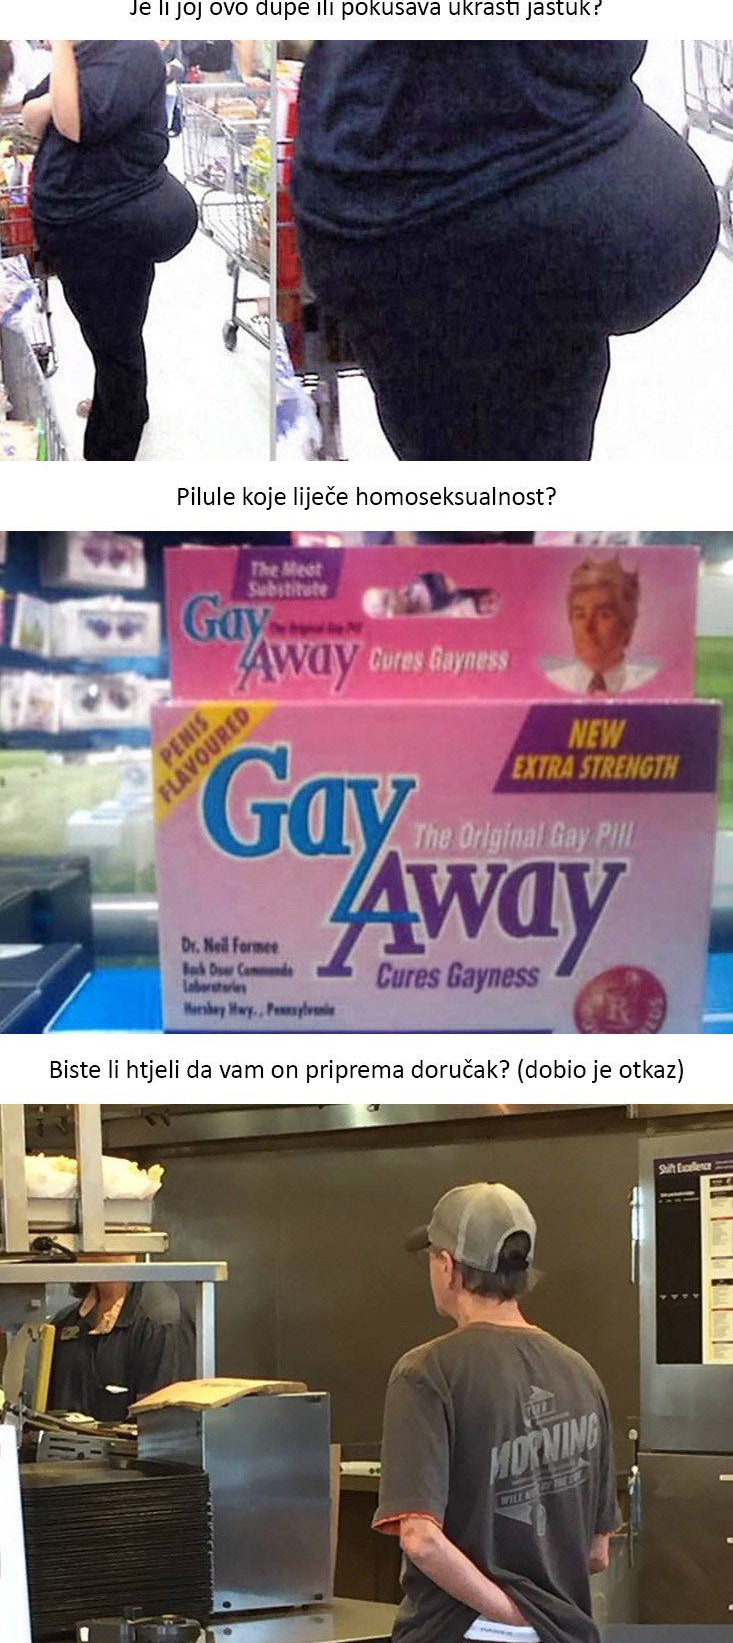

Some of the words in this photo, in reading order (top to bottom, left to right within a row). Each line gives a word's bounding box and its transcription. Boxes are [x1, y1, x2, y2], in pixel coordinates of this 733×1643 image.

[250, 560, 280, 577] The
[248, 581, 330, 599] Substitute
[181, 592, 272, 669] Gay
[236, 636, 362, 693] Away
[369, 645, 424, 673] Cures
[429, 644, 511, 676] Gayness
[159, 710, 210, 767] PENIS
[568, 718, 628, 750] NEW
[157, 706, 251, 805] FLAVOURED
[511, 754, 575, 781] EXTRA
[578, 753, 681, 781] STRENGTH
[202, 743, 420, 923] Gay
[413, 821, 452, 850] The
[459, 821, 544, 854] Original
[549, 821, 590, 854] Gay
[596, 821, 635, 849] Pill
[316, 850, 628, 977] Away
[182, 935, 200, 954] Dr.
[204, 935, 229, 954] Neil
[376, 961, 441, 990] Cures
[446, 960, 541, 994] Gayness
[490, 1412, 599, 1486] MORNING
